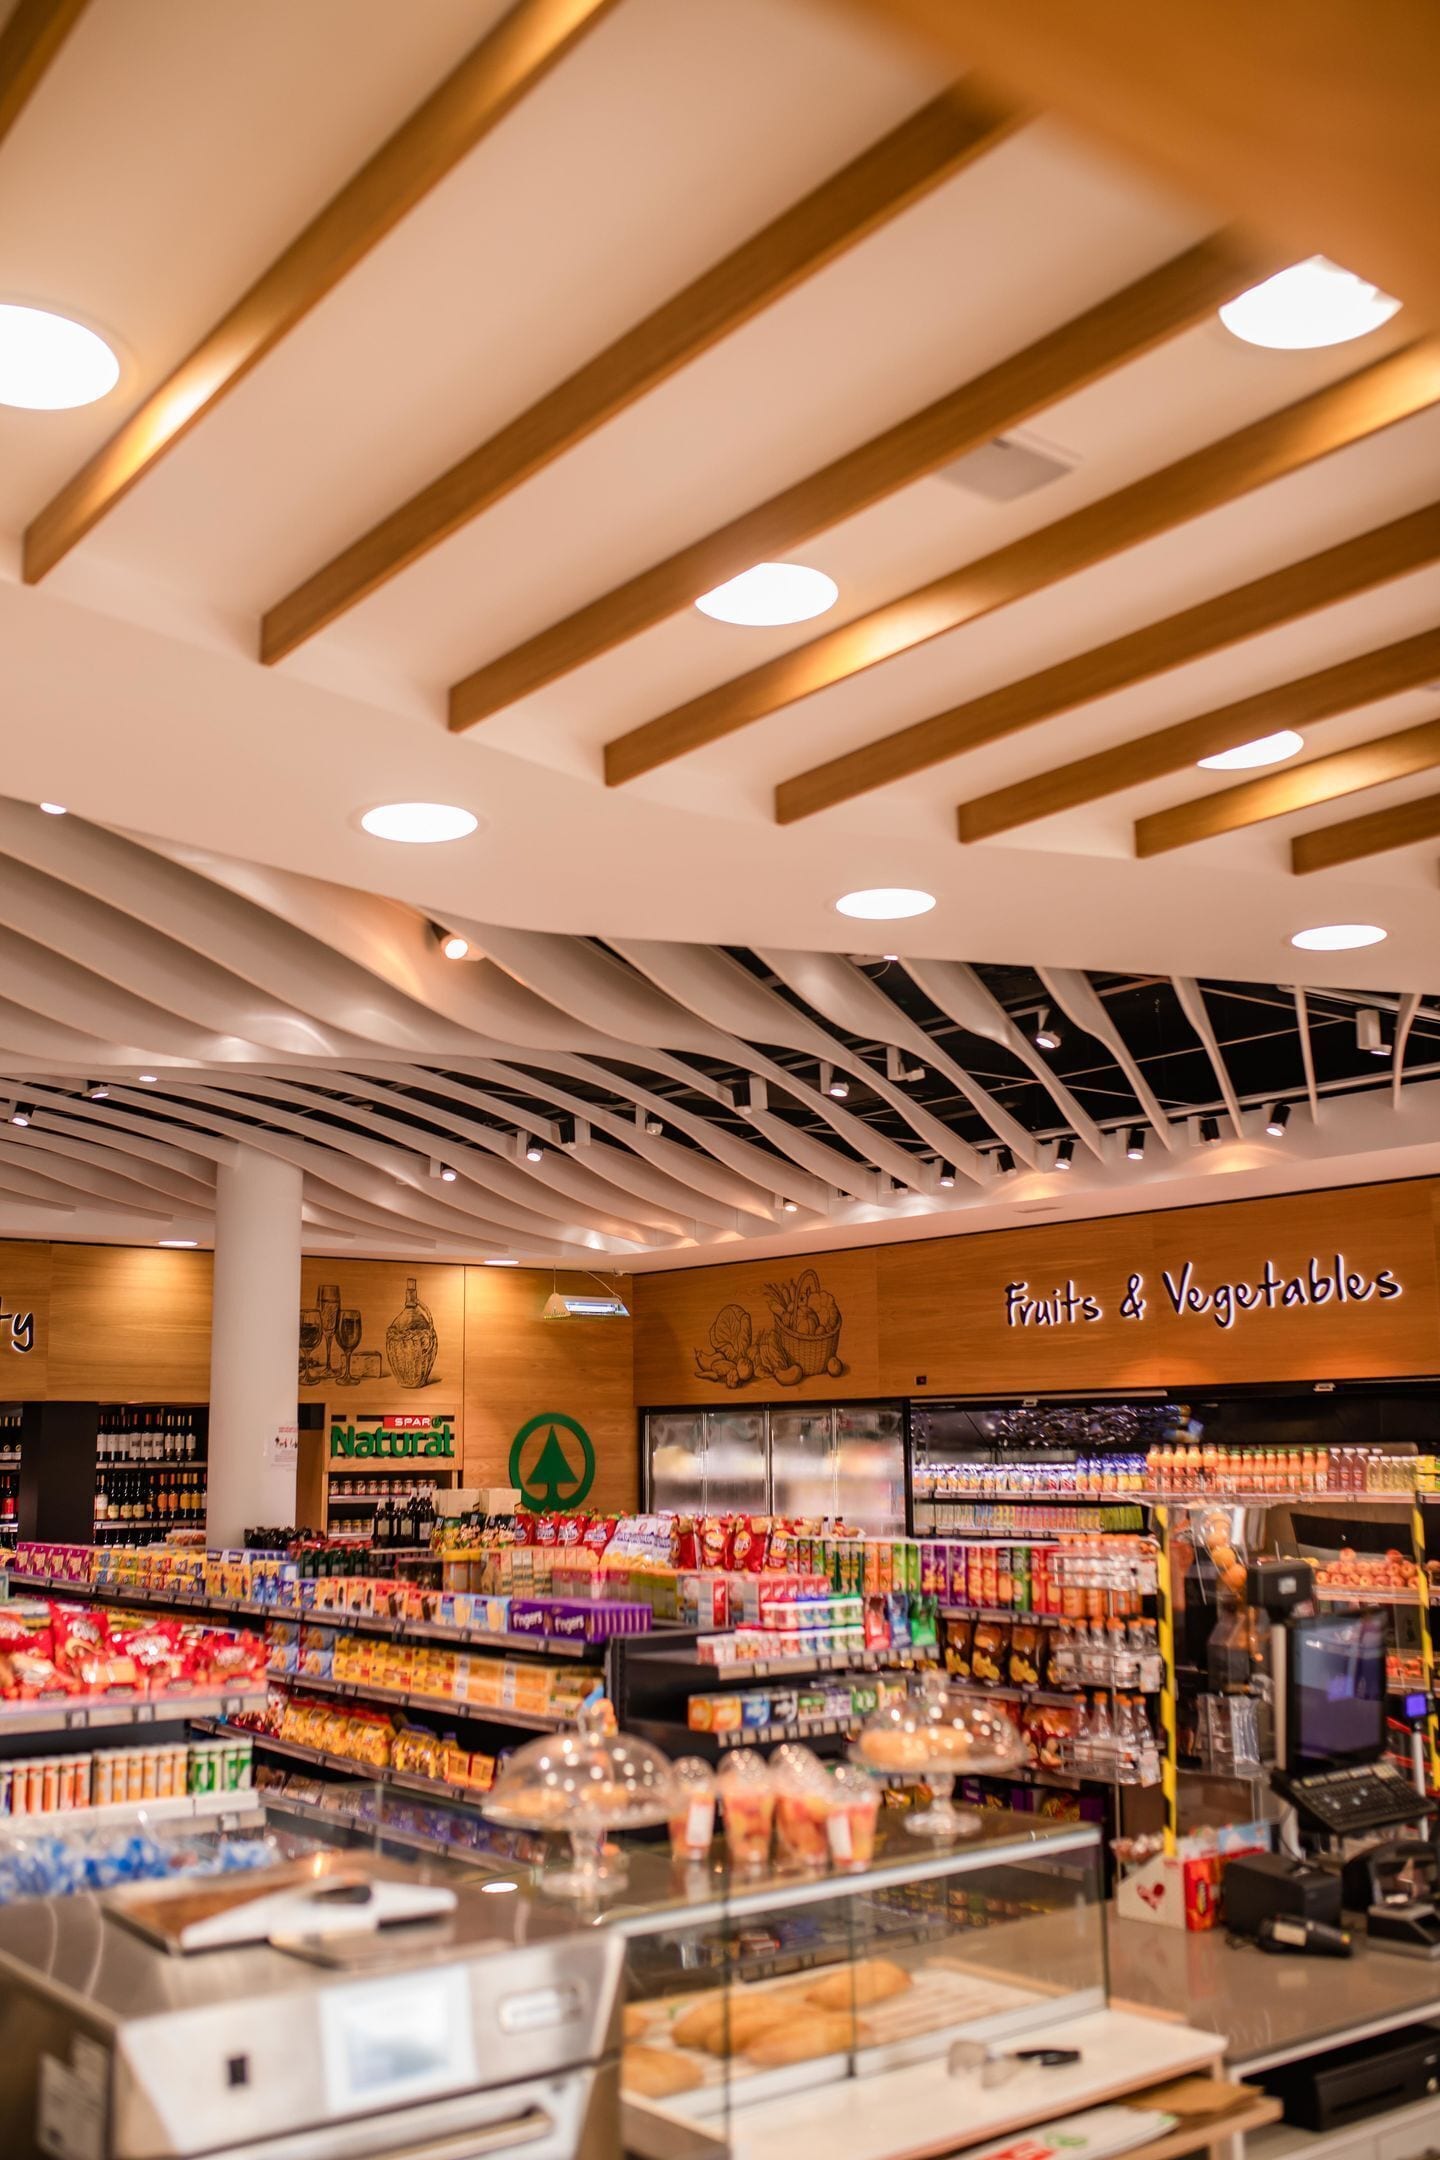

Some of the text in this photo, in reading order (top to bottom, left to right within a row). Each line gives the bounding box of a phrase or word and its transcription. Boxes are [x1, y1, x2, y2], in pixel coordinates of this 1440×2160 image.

[1005, 1253, 1402, 1329] Fruits & Vegetables
[394, 1416, 431, 1427] SPAR
[330, 1424, 455, 1457] Natural
